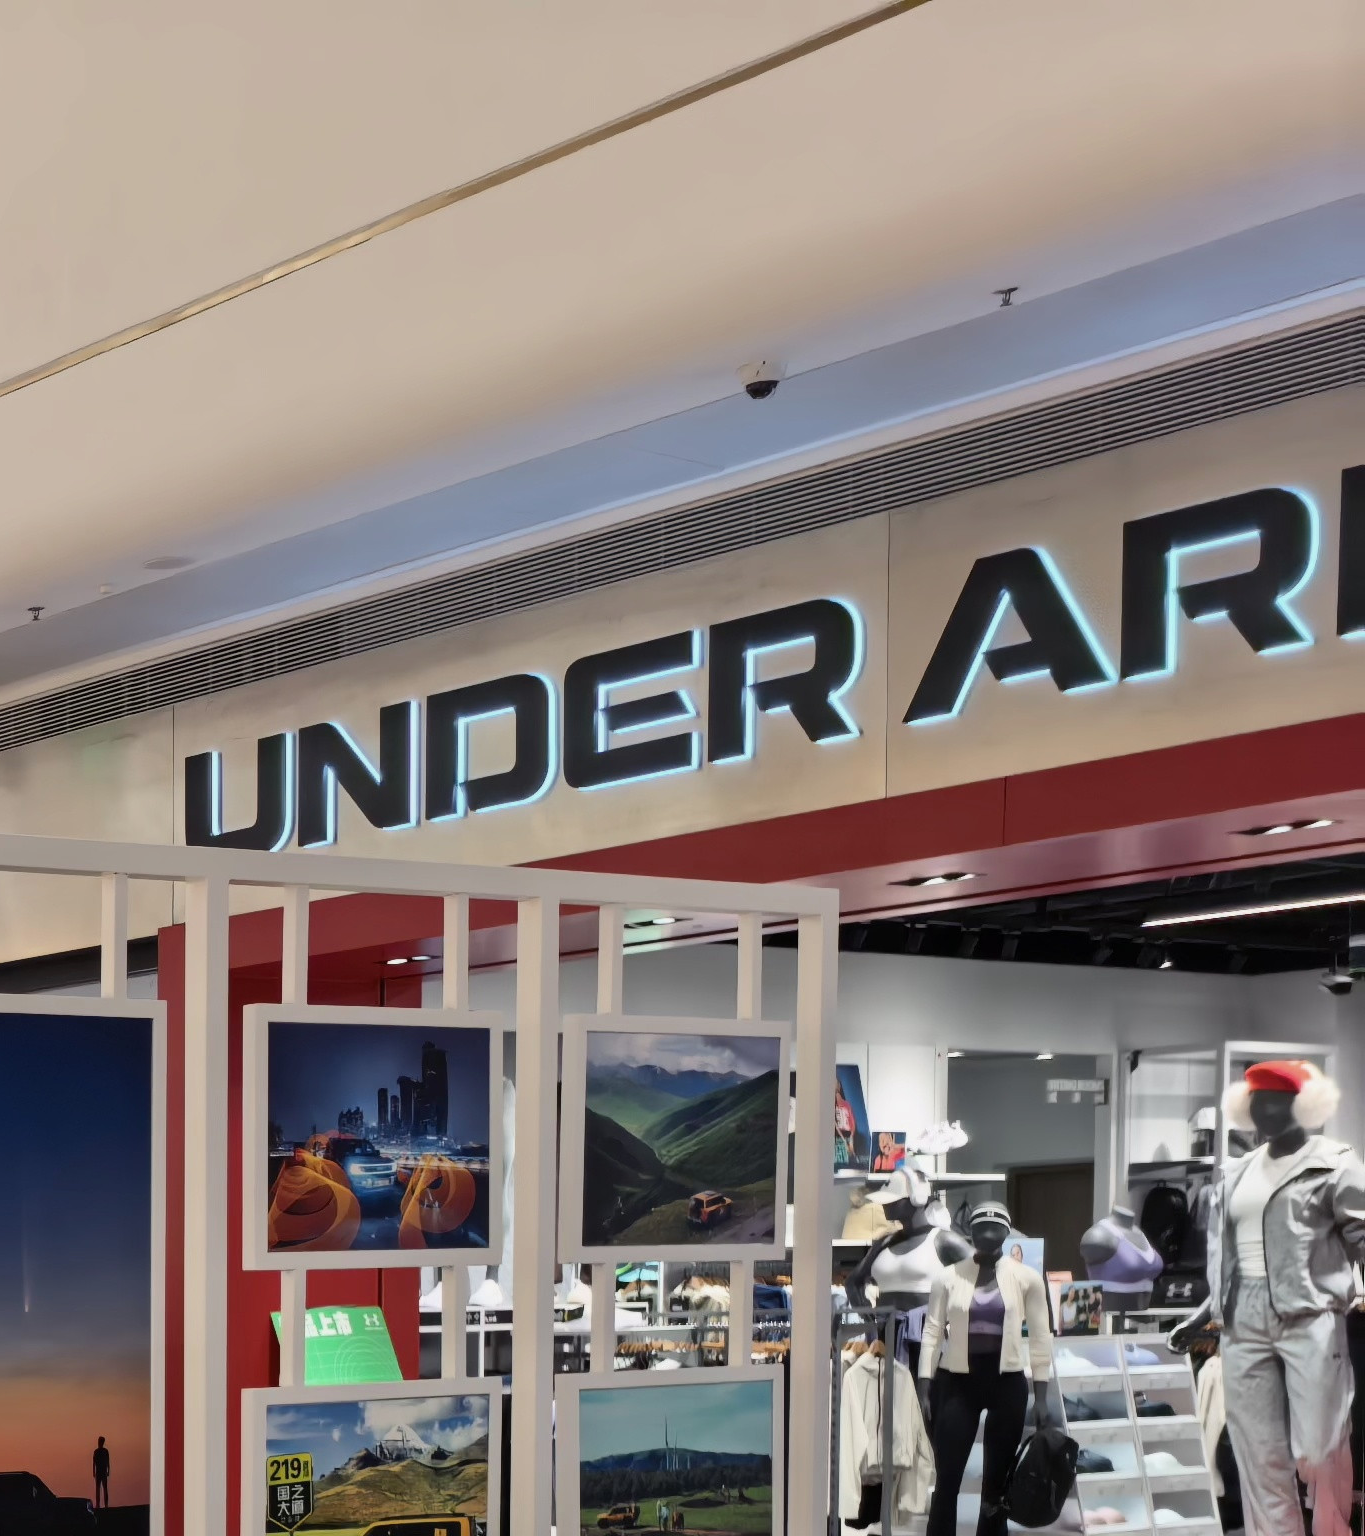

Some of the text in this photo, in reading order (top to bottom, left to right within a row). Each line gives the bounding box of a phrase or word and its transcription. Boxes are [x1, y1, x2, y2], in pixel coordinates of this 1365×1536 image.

[185, 463, 1365, 851] UNDER AR
[270, 1458, 302, 1481] 219
